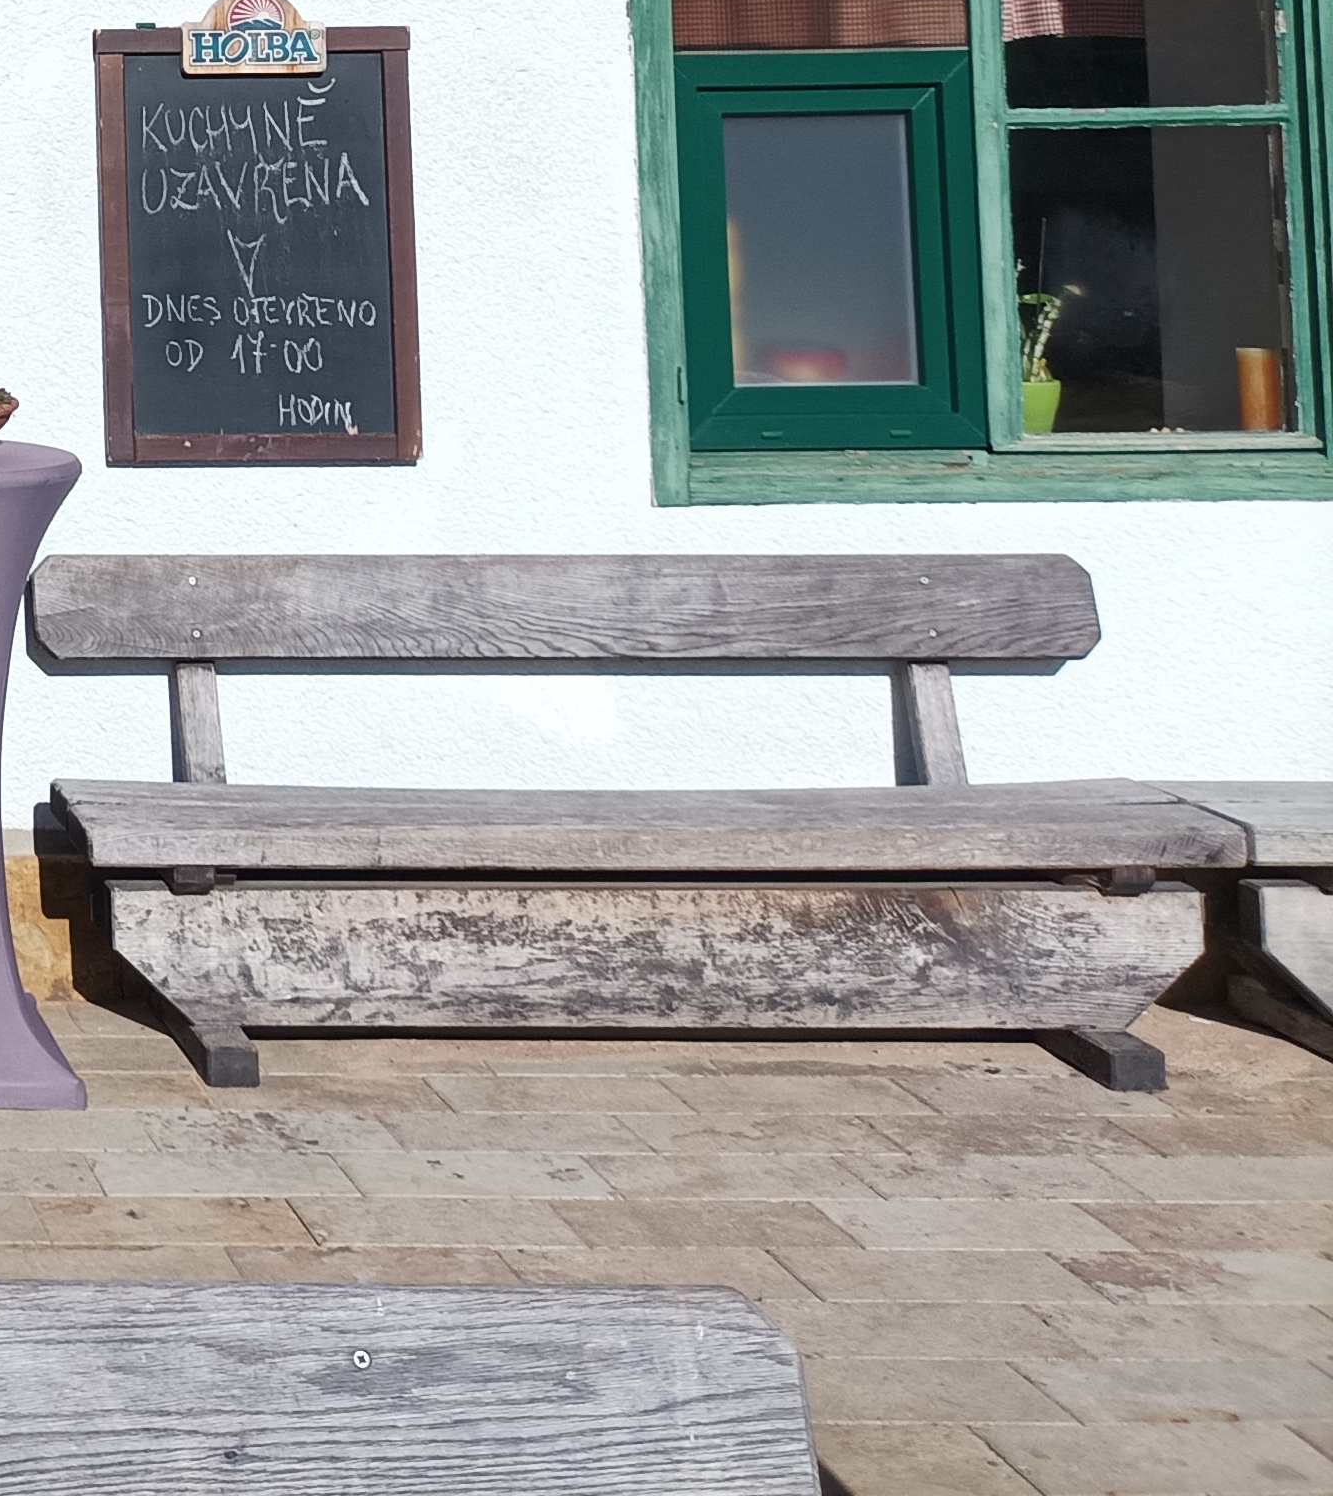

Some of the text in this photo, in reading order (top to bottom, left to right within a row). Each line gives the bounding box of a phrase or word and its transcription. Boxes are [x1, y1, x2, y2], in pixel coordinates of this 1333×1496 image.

[141, 77, 337, 155] KUCHYNĚ
[141, 151, 370, 224] UZAVŘENA
[141, 293, 222, 328] DNES
[165, 339, 204, 372] OD
[278, 393, 356, 430] HODIN
